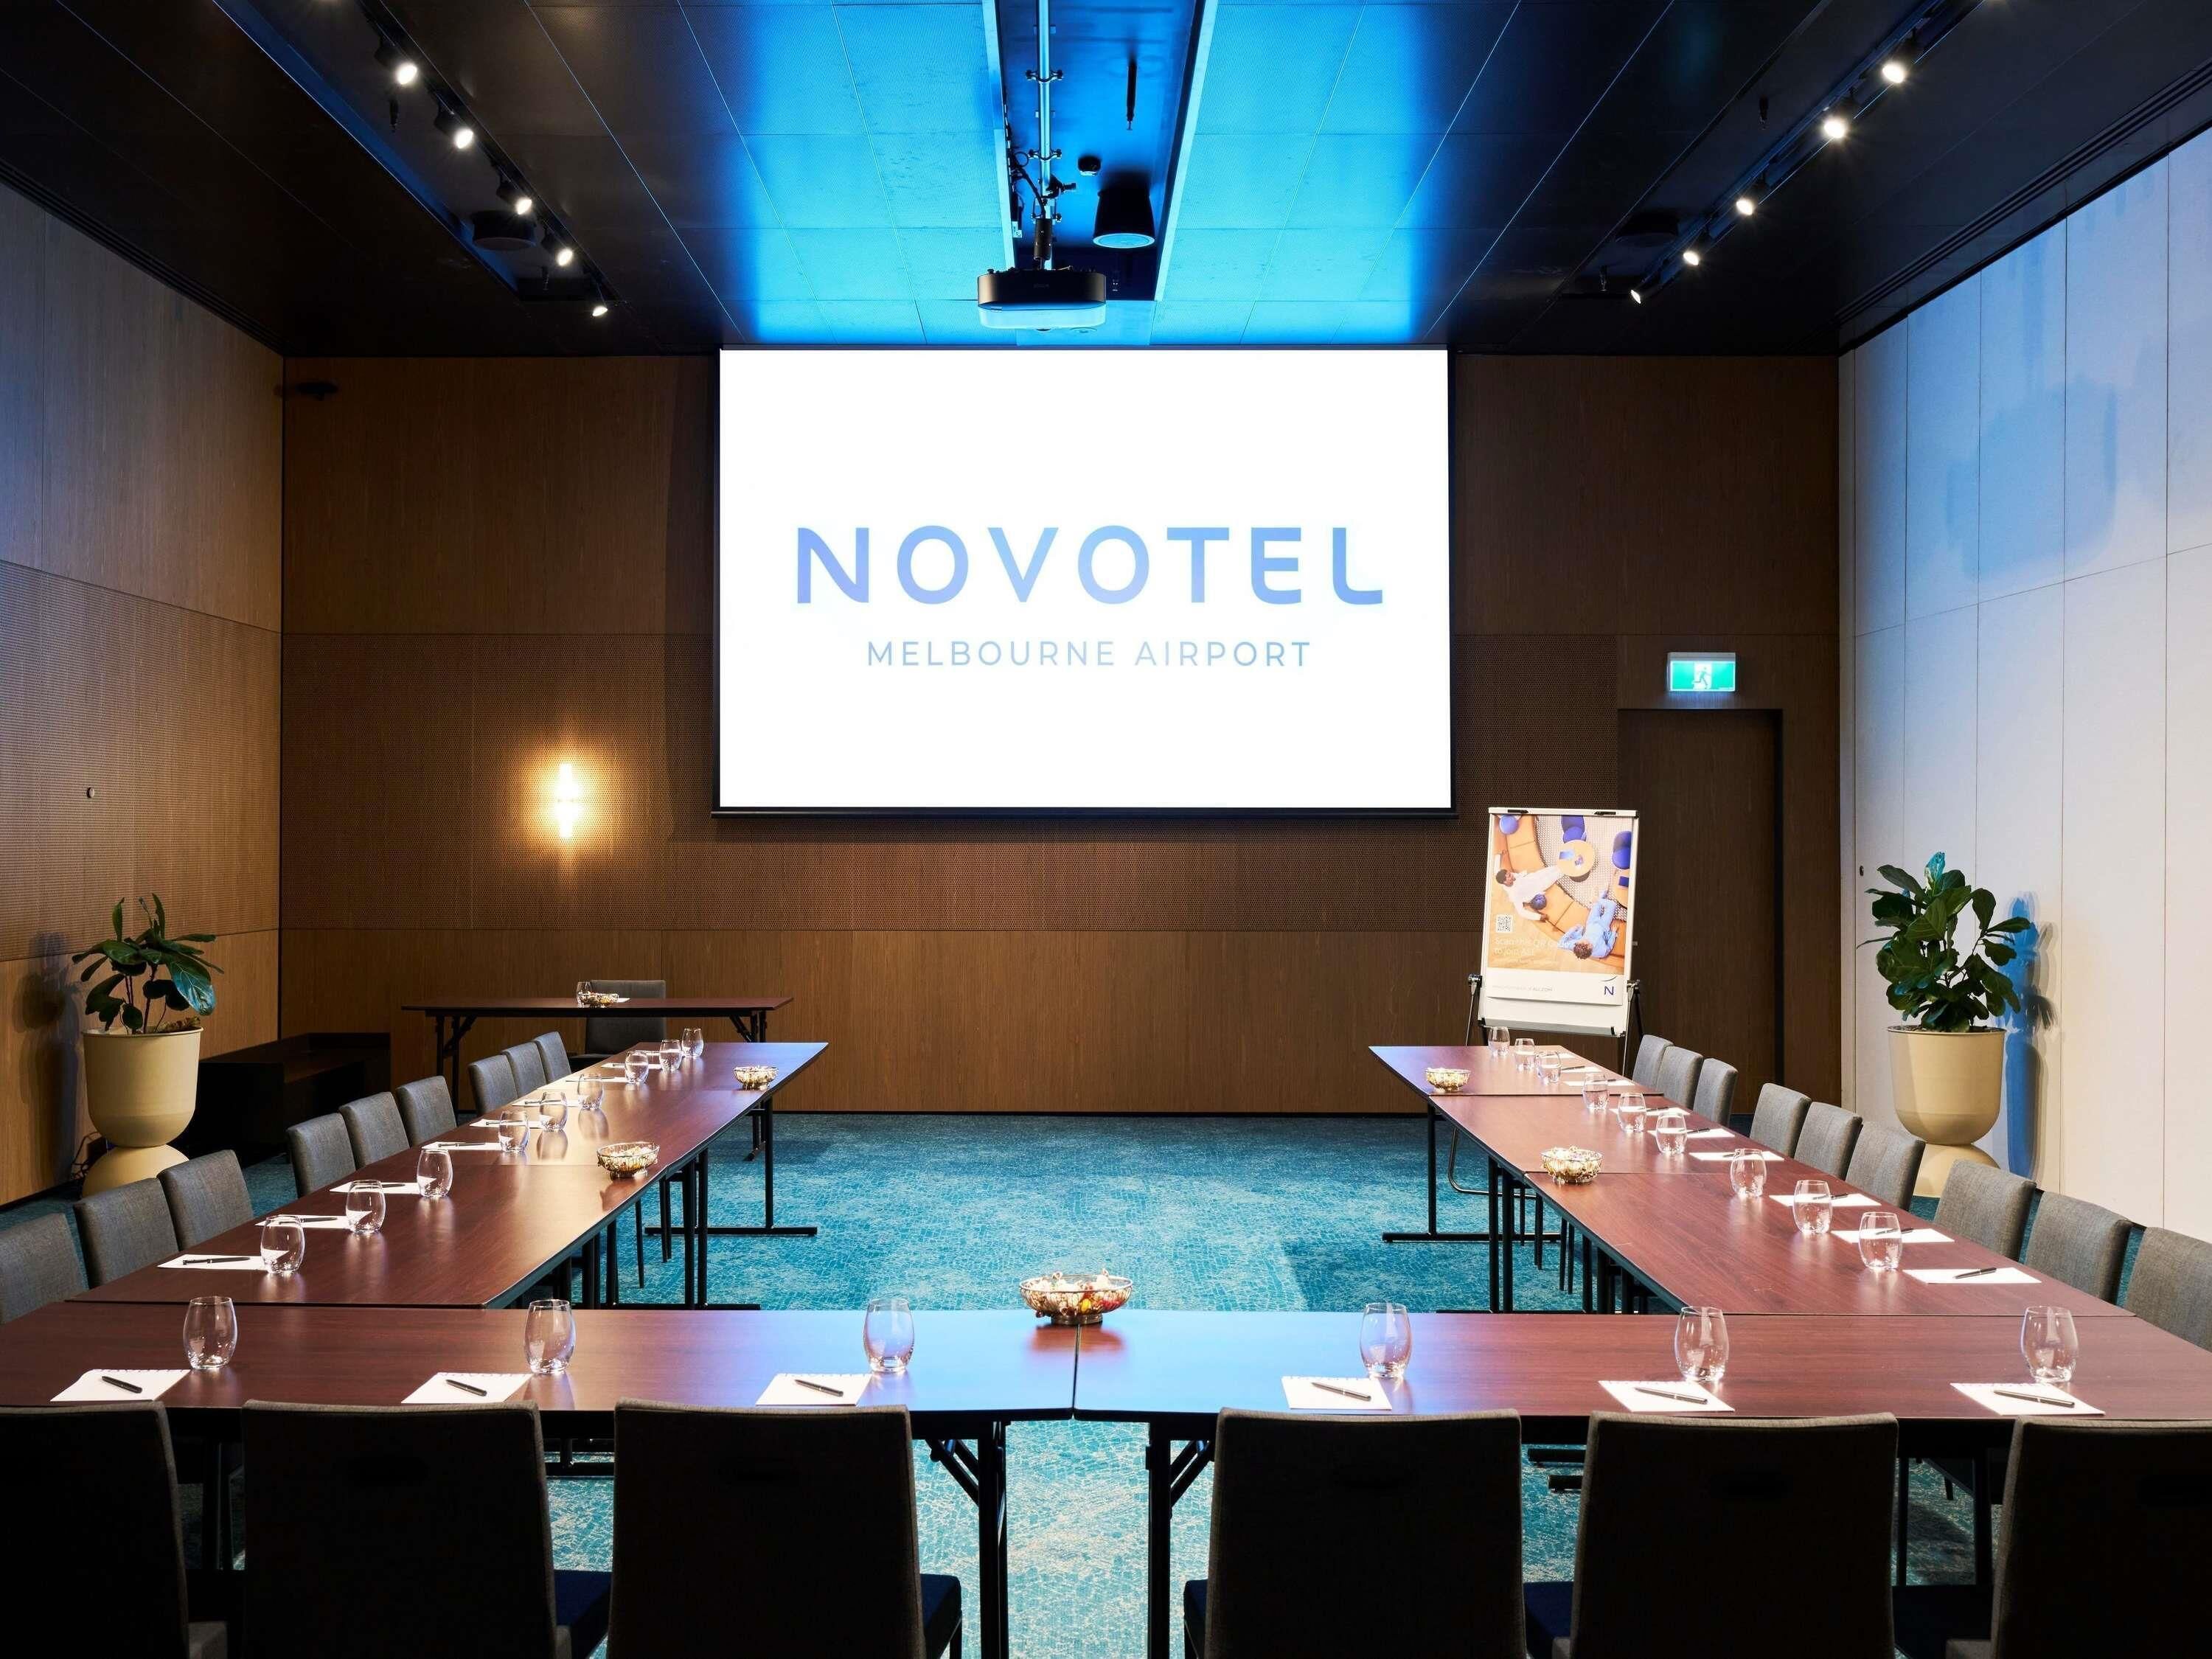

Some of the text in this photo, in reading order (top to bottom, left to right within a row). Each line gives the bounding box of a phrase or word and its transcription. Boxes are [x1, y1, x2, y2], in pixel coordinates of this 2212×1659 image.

[797, 525, 1383, 605] NOVOTEL
[867, 640, 1310, 667] MELBOURNE AIRPORT
[1604, 985, 1614, 995] N
